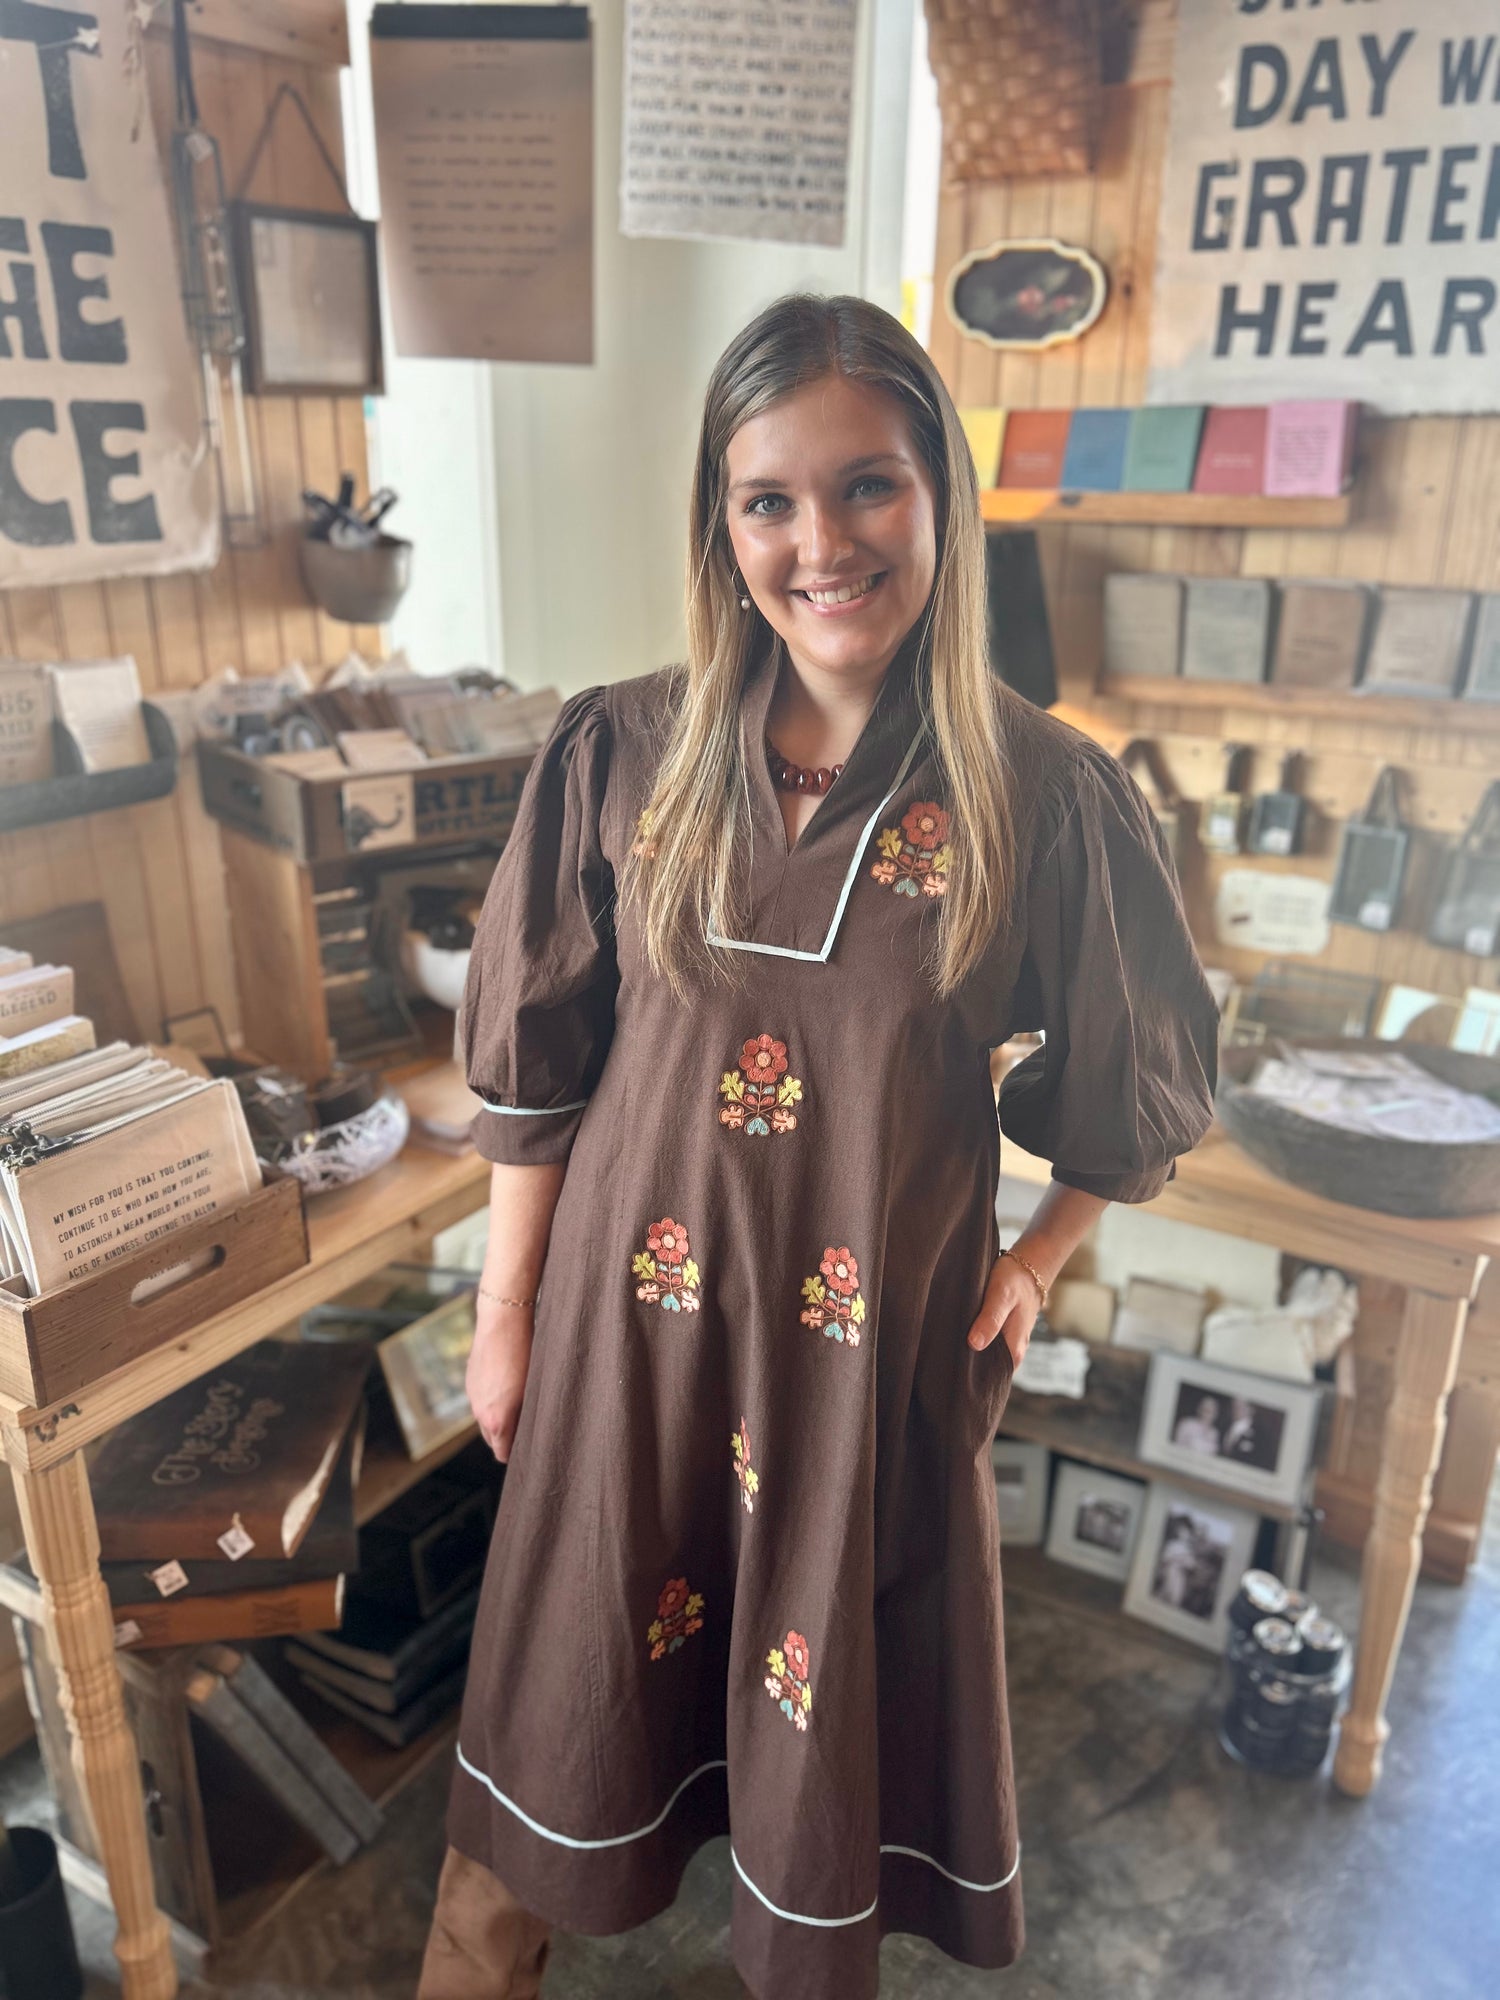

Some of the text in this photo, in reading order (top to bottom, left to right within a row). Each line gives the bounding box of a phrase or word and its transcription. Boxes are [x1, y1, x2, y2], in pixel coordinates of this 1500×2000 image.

[1234, 29, 1500, 129] DAY W
[1191, 144, 1500, 252] GRATE
[1213, 278, 1498, 357] HEAR
[53, 1212, 65, 1225] MY
[67, 1202, 87, 1218] WISH
[89, 1194, 105, 1209] FOR
[107, 1186, 124, 1200] YOU
[125, 1182, 134, 1193] IS
[136, 1172, 156, 1187] THAT
[159, 1164, 175, 1178] YOU
[58, 1218, 96, 1244] CONTINUE
[98, 1212, 109, 1225] TO
[111, 1206, 122, 1219] BE
[125, 1198, 142, 1212] WHO
[145, 1191, 160, 1204] AND
[162, 1183, 177, 1197] HOW
[180, 1175, 194, 1188] YOU
[63, 1184, 211, 1262] TO ASTONISH A MEAN WORLD WITH YOUR
[69, 1200, 217, 1280] ACTS OF KINDNESS. CONTINUE TO ALLOW
